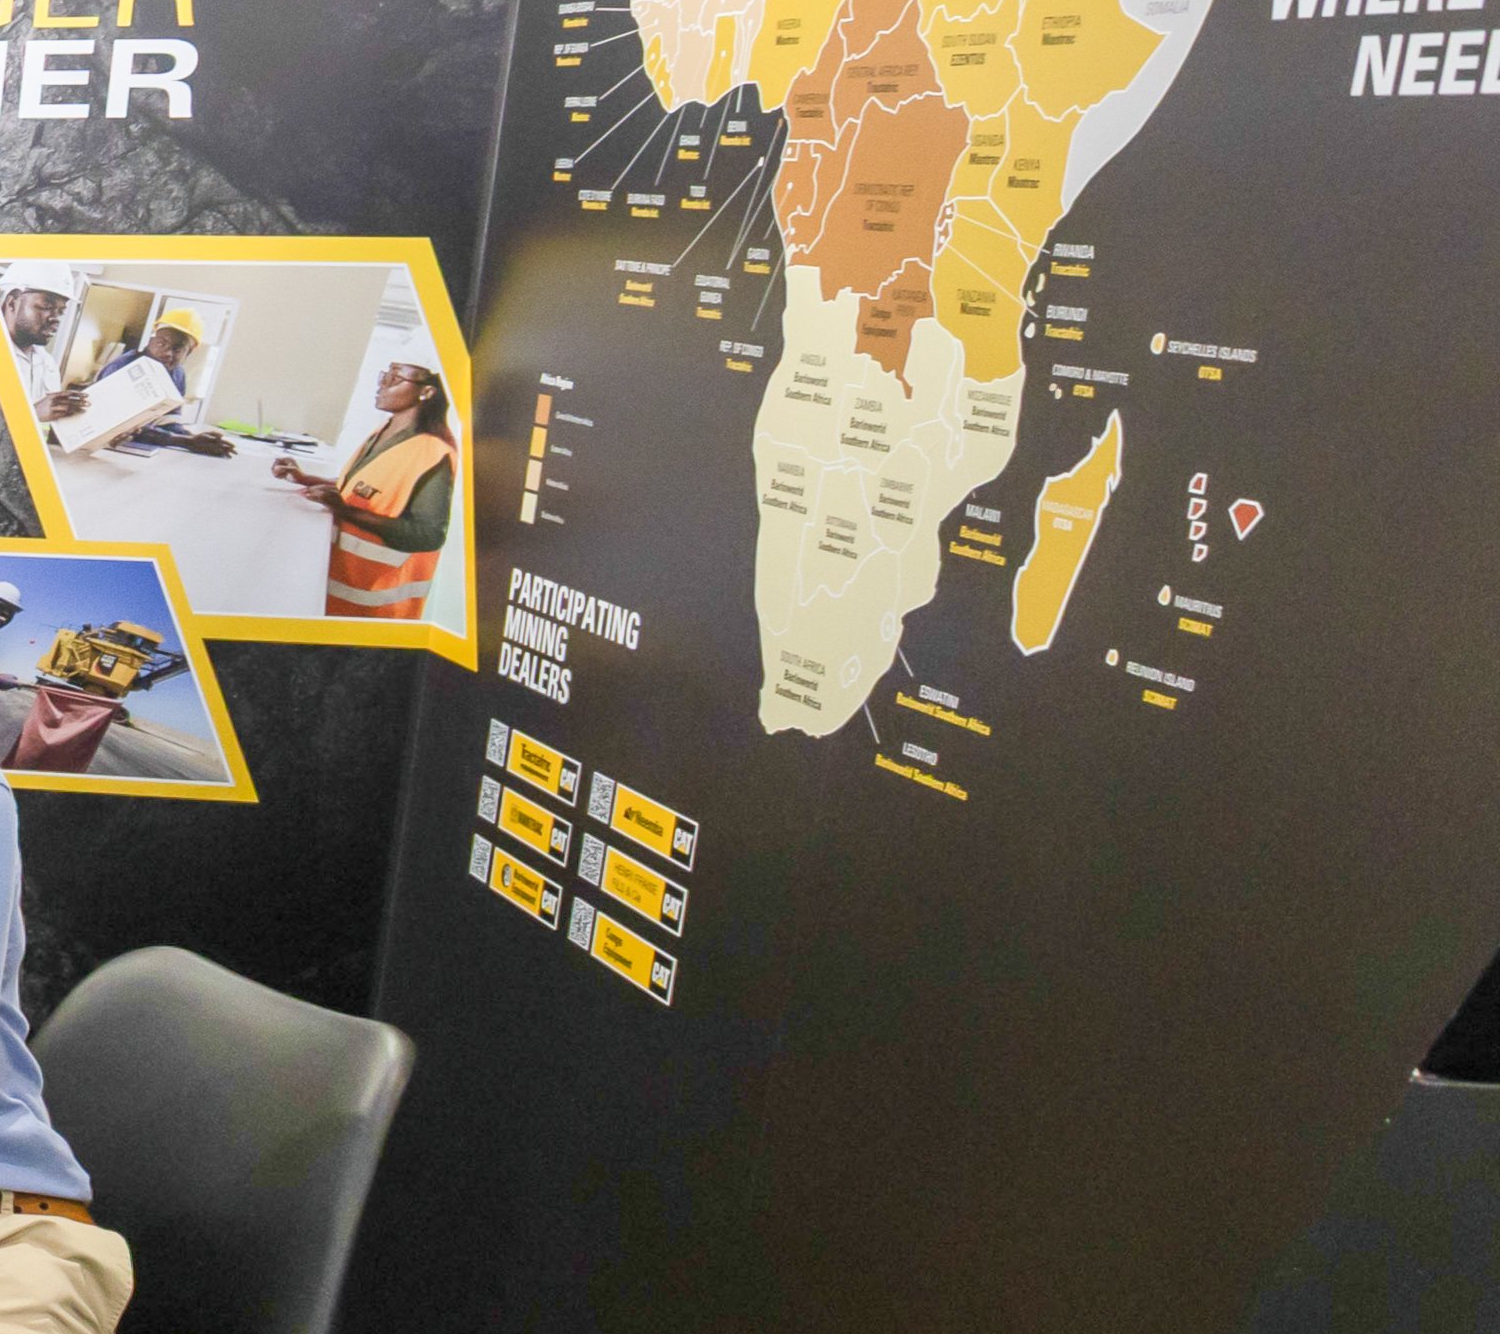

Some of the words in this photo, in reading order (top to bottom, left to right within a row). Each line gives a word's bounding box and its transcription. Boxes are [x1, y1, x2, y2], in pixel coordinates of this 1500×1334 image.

[508, 568, 641, 650] PARTICIPATING
[503, 605, 568, 663] MINING
[498, 641, 572, 705] DEALERS
[560, 768, 577, 792] CAT
[550, 827, 567, 852] CAT
[674, 827, 693, 855] CAT
[541, 890, 558, 915] CAT
[663, 893, 682, 921] CAT
[652, 961, 670, 990] CAT
